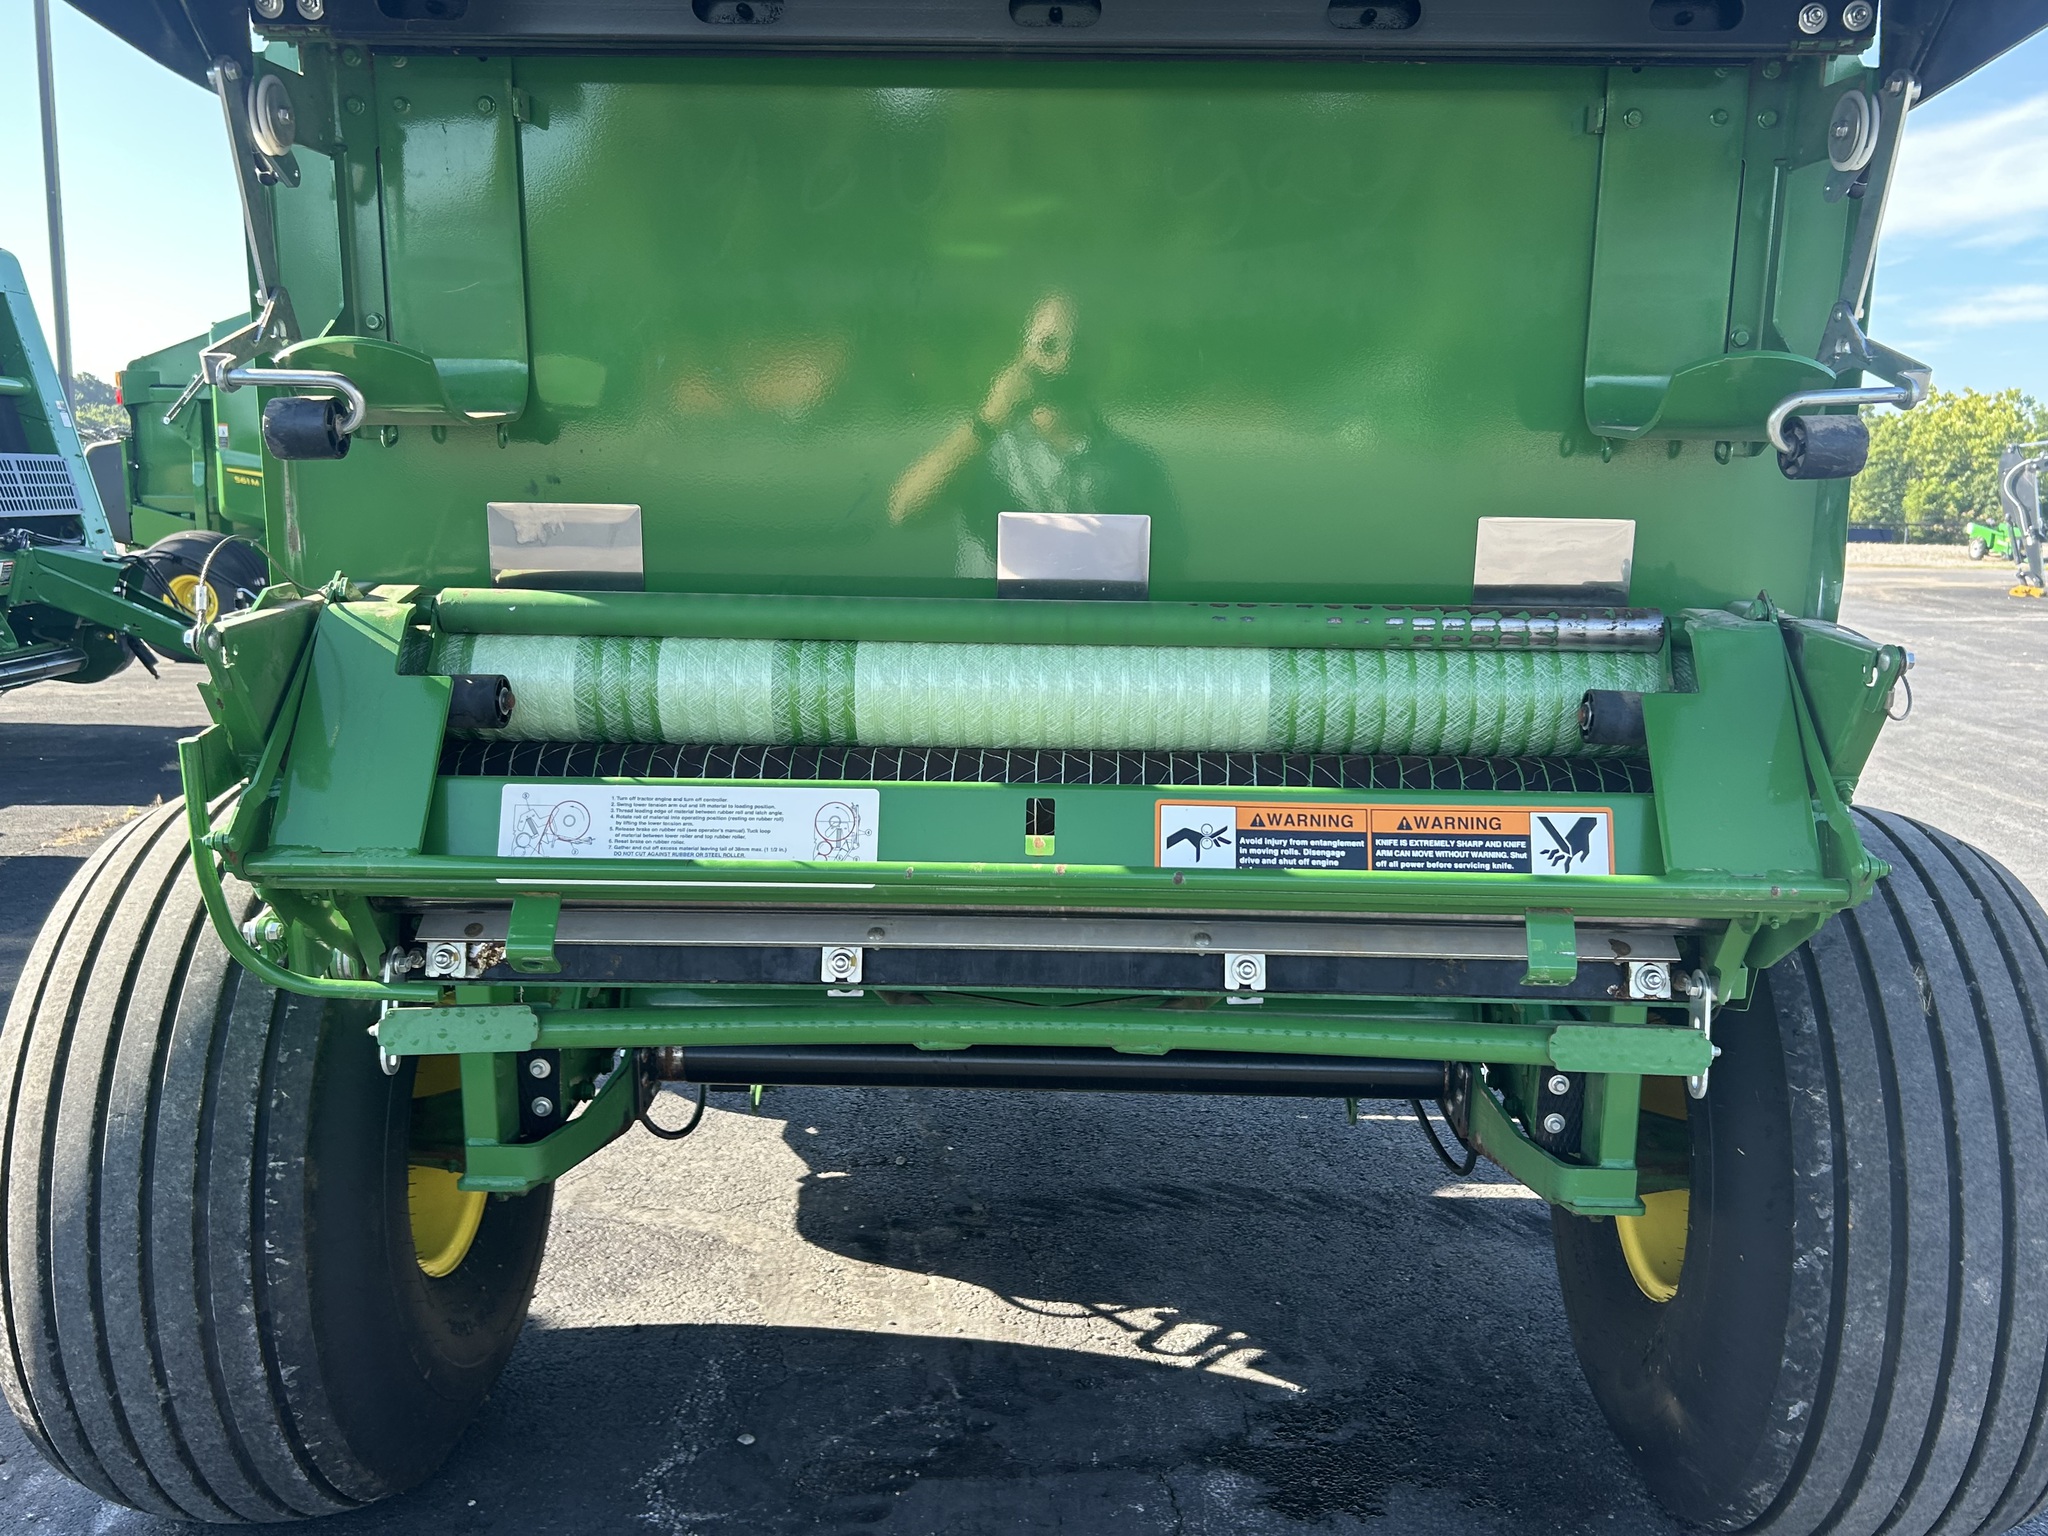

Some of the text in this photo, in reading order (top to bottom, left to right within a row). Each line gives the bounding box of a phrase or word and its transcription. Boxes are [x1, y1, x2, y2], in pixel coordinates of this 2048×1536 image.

[1267, 813, 1354, 828] WARNING
[1414, 816, 1501, 830] WARNING
[1240, 837, 1263, 845] Avoid
[1264, 838, 1288, 847] injury
[1310, 840, 1365, 848] entanglement
[1456, 840, 1484, 848] SHARP
[1250, 848, 1279, 857] moving
[1280, 848, 1301, 856] rolls.
[1303, 849, 1346, 858] Disengage
[1278, 858, 1296, 866] shut
[1298, 858, 1310, 866] off
[1311, 860, 1339, 868] engine
[1388, 860, 1398, 868] all
[1454, 862, 1490, 870] servicing
